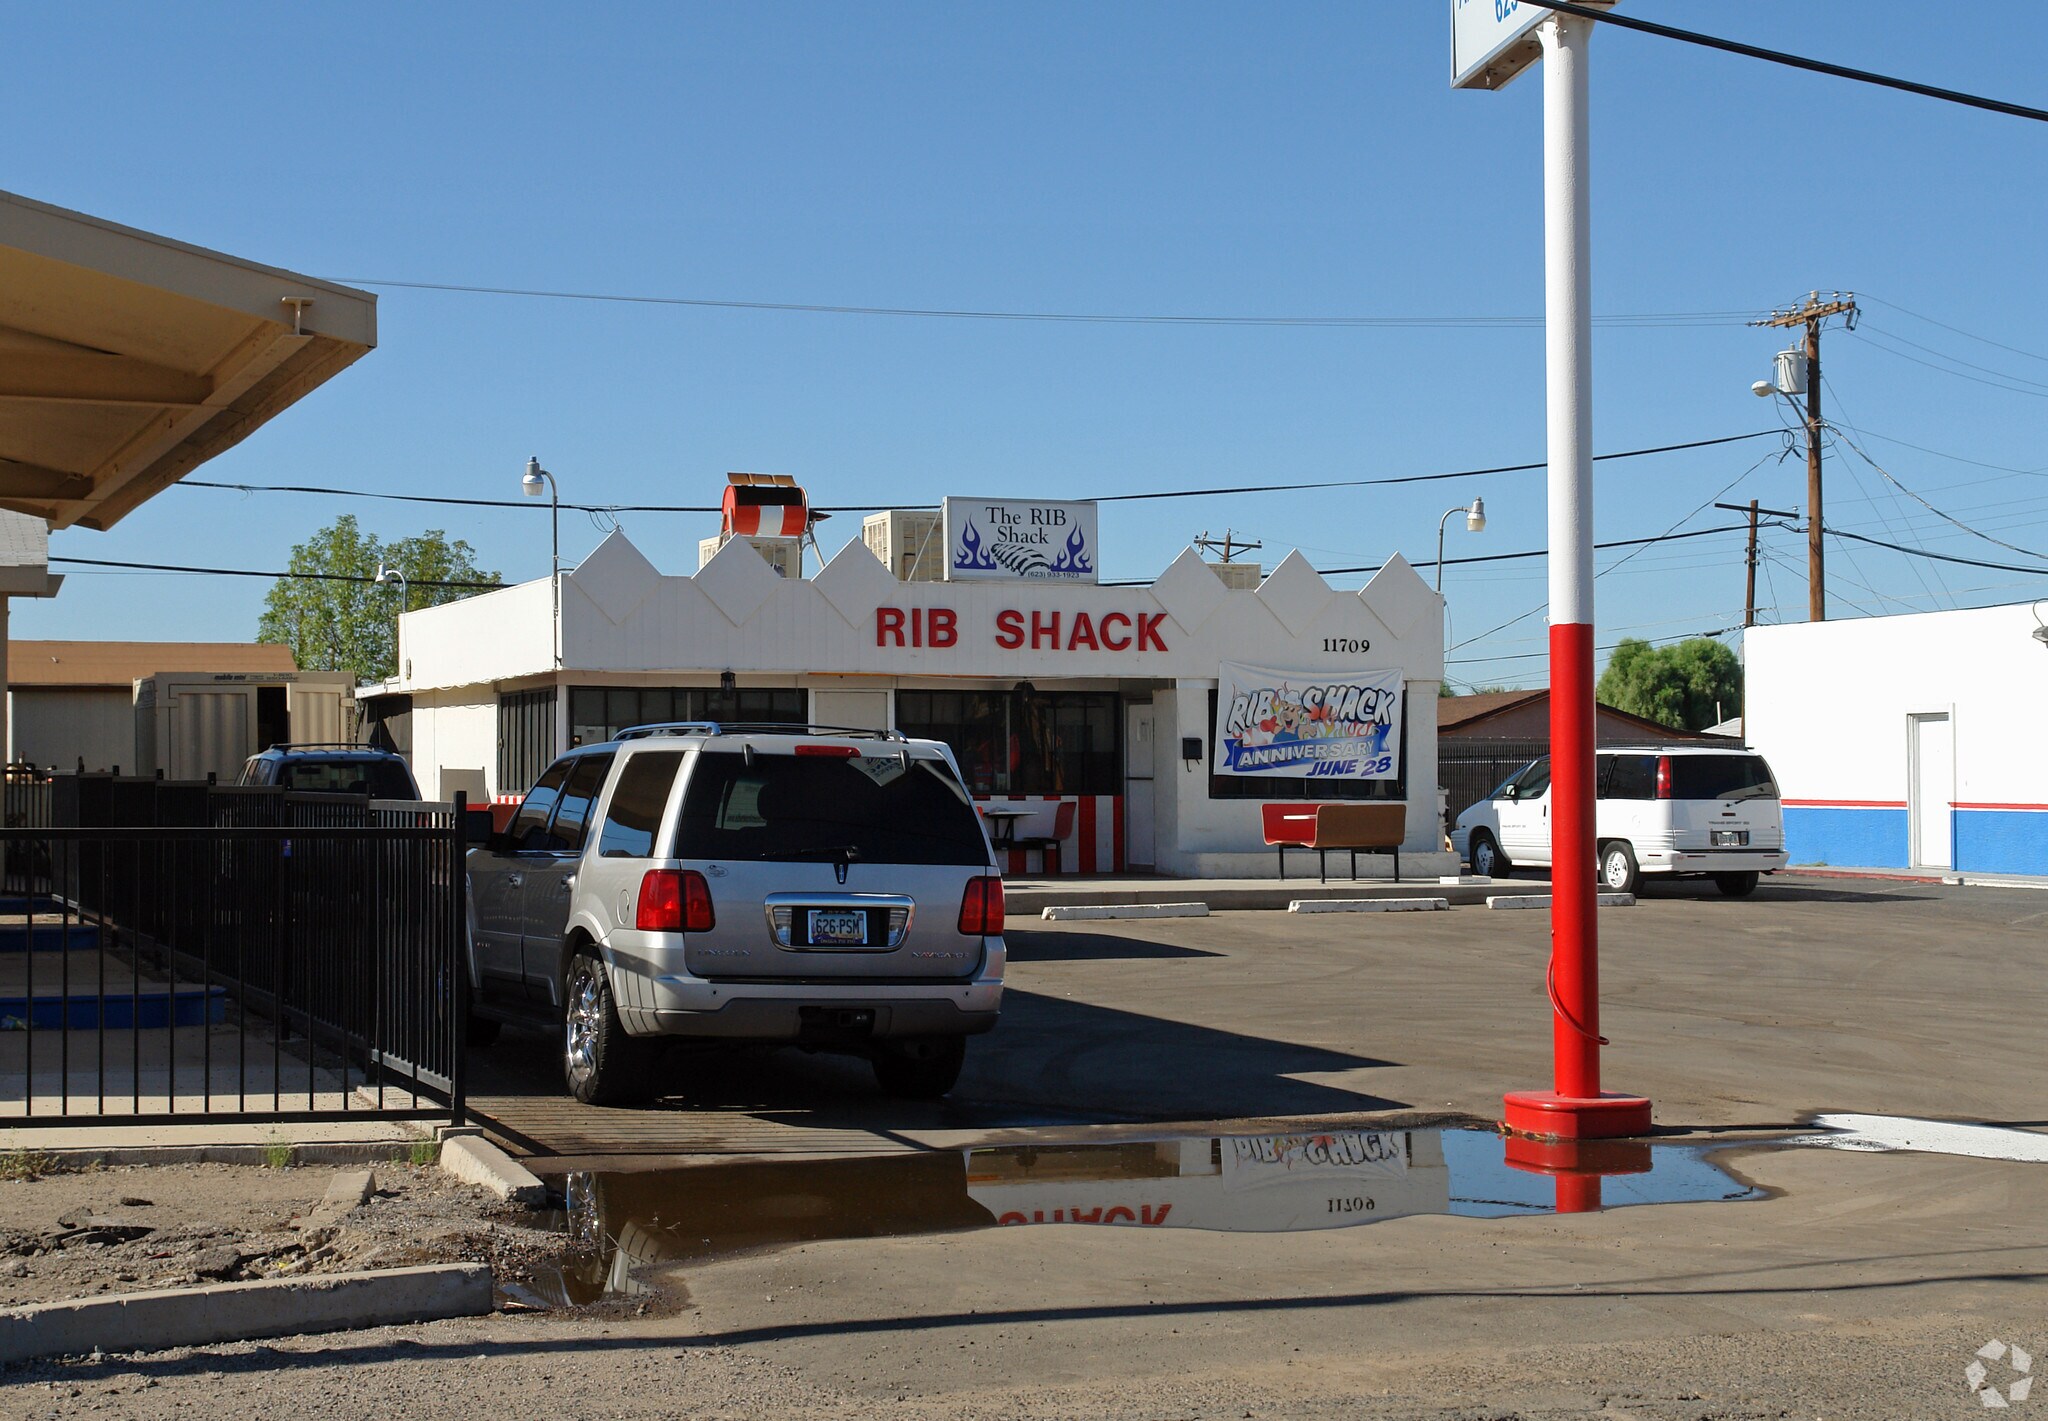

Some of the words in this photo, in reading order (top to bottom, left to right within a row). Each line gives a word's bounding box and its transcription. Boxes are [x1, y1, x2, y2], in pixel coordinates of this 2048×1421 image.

[985, 506, 1021, 525] The
[1029, 508, 1067, 526] RIB
[997, 525, 1050, 545] Shack
[876, 607, 959, 648] RIB
[995, 609, 1169, 652] SHACK
[1323, 638, 1370, 653] 11709
[1226, 687, 1275, 734] RIB
[1301, 684, 1396, 725] SHACK
[1238, 740, 1374, 768] ANNIVERSARY
[1305, 758, 1359, 777] JUNE
[1361, 756, 1392, 777] 28
